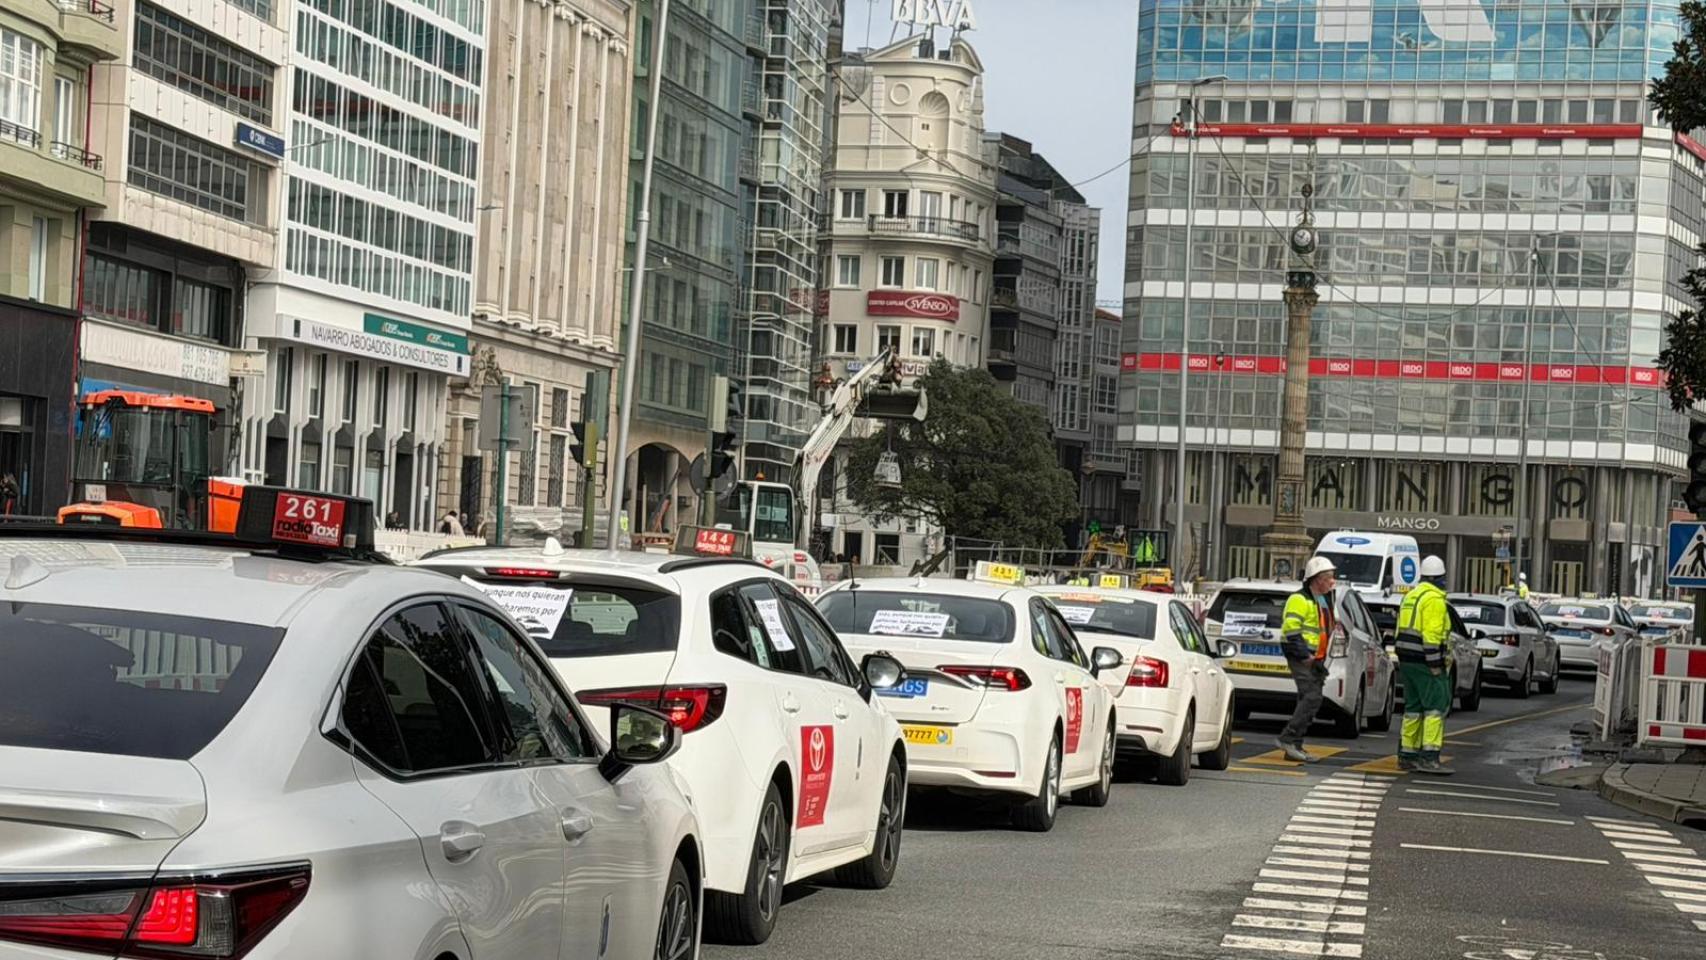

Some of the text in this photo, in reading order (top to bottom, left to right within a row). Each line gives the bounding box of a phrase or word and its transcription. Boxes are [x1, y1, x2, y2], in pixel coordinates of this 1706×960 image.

[891, 0, 977, 31] BBVA
[910, 299, 949, 312] SVENSON
[312, 325, 449, 369] NAVARRO ABOGADOS & CONSULTORES
[1235, 464, 1588, 508] MANGO
[284, 497, 331, 522] 261
[275, 520, 340, 539] radioTaxi
[1378, 515, 1440, 530] MANGO
[701, 531, 729, 544] 144
[515, 590, 531, 598] nos
[532, 591, 565, 603] quieran
[541, 606, 558, 617] por
